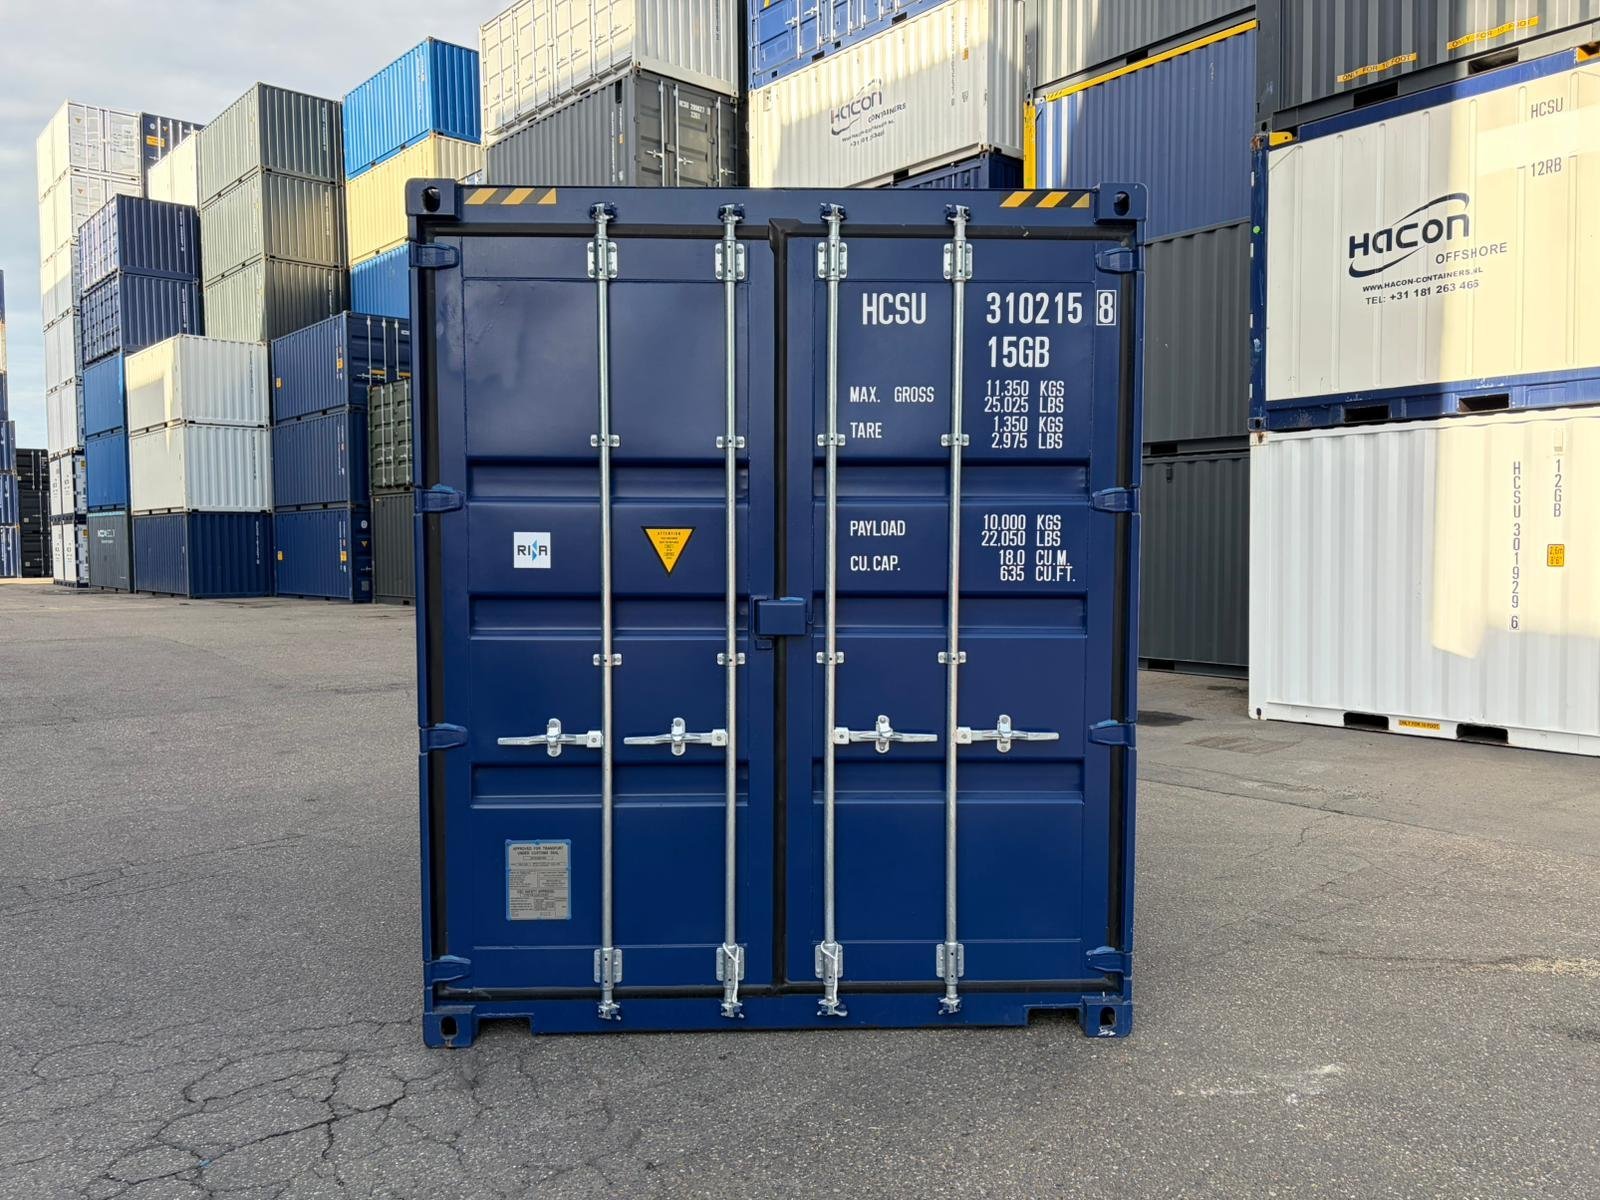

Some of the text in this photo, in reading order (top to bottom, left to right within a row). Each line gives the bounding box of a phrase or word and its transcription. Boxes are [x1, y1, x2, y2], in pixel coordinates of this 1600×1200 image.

[1531, 97, 1563, 119] HCSU
[1531, 157, 1562, 177] 12RB
[1435, 242, 1508, 264] OFFSHORE
[1365, 296, 1386, 305] TEL:
[1389, 290, 1409, 301] +31
[1413, 287, 1431, 298] 181
[1436, 282, 1456, 294] 263
[862, 291, 1116, 325] HCSU 310215 8
[988, 336, 1050, 368] 15GB
[849, 386, 935, 403] MAX. GROSS
[1039, 380, 1065, 397] KGS
[1039, 397, 1064, 413] LBS
[849, 422, 882, 439] TARE
[1038, 416, 1064, 433] KGS
[1038, 433, 1063, 449] LBS
[1553, 458, 1563, 518] 12GB
[850, 519, 906, 537] PAYLOAD
[1036, 514, 1062, 531] KGS
[1036, 530, 1061, 547] LBS
[1510, 461, 1521, 629] HCSU 301929 6
[999, 549, 1025, 565] 18.0
[1000, 565, 1025, 581] 635
